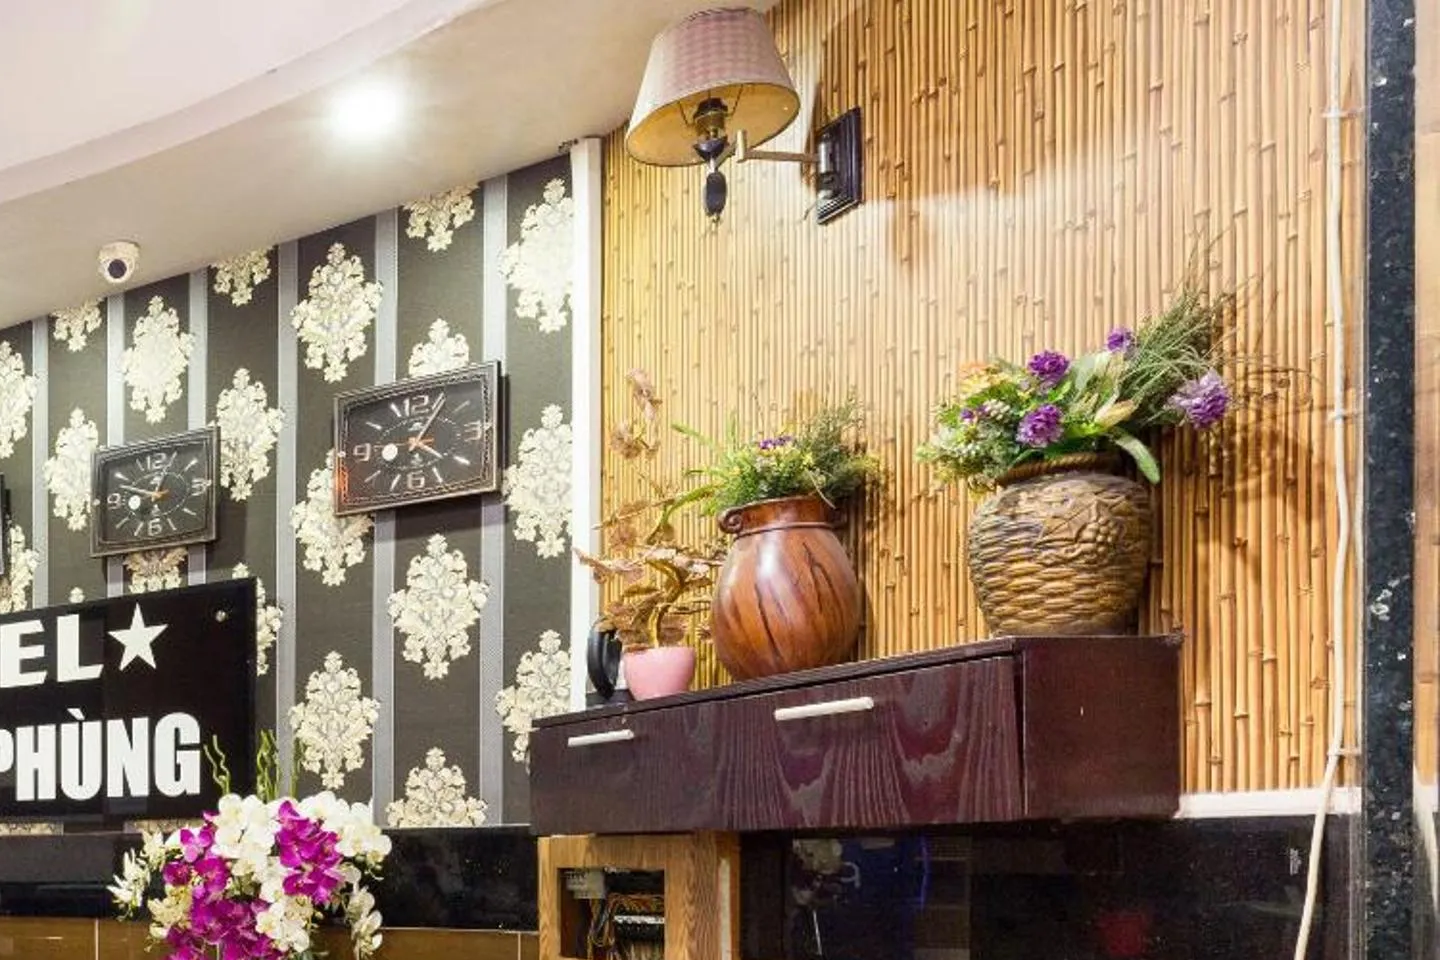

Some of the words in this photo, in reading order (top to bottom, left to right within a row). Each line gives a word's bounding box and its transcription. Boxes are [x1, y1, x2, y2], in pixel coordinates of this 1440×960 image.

[403, 395, 429, 416] 12
[463, 420, 482, 442] 3
[146, 452, 166, 470] 12
[353, 443, 371, 462] 9
[407, 470, 425, 489] 6
[107, 493, 121, 510] 9
[147, 518, 162, 536] 6
